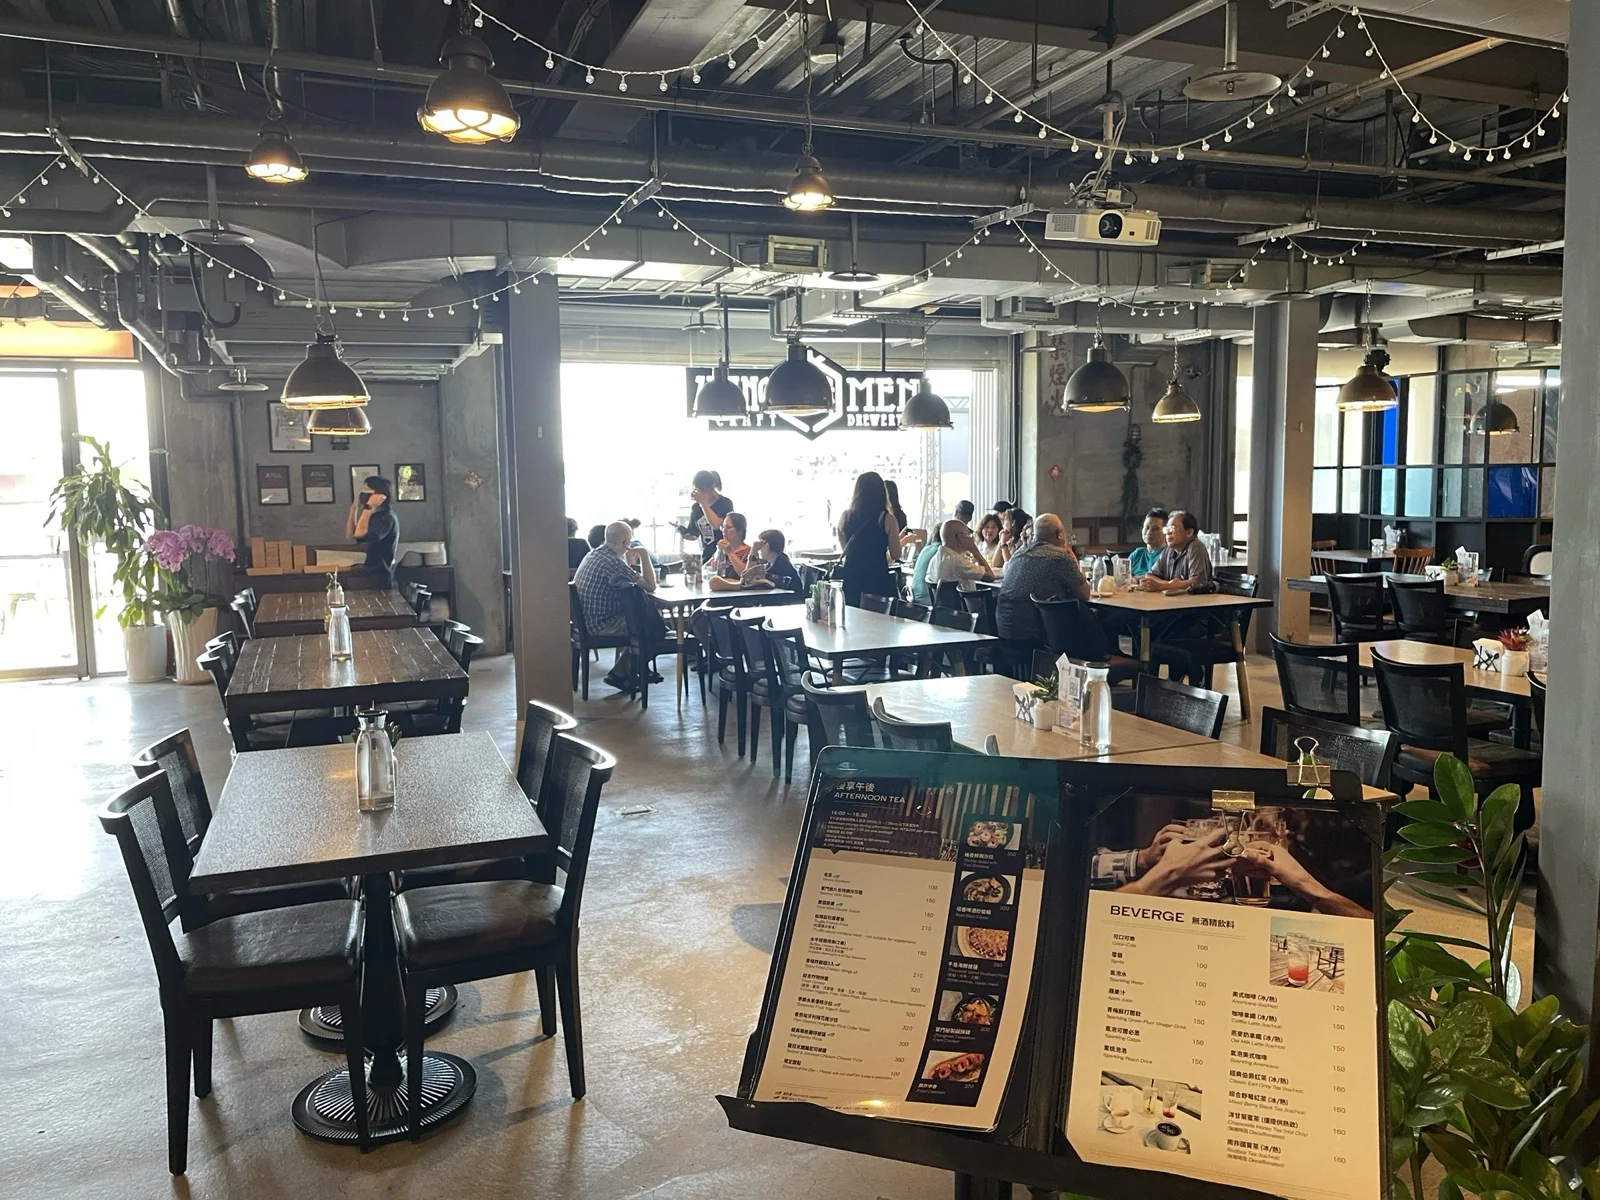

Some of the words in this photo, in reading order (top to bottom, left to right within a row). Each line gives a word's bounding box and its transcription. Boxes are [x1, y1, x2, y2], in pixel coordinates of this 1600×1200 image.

[834, 792, 887, 801] AFTERNOON
[1110, 906, 1185, 922] BEVERGE
[1192, 916, 1234, 929] 無酒精飲料
[1333, 1128, 1346, 1136] 160
